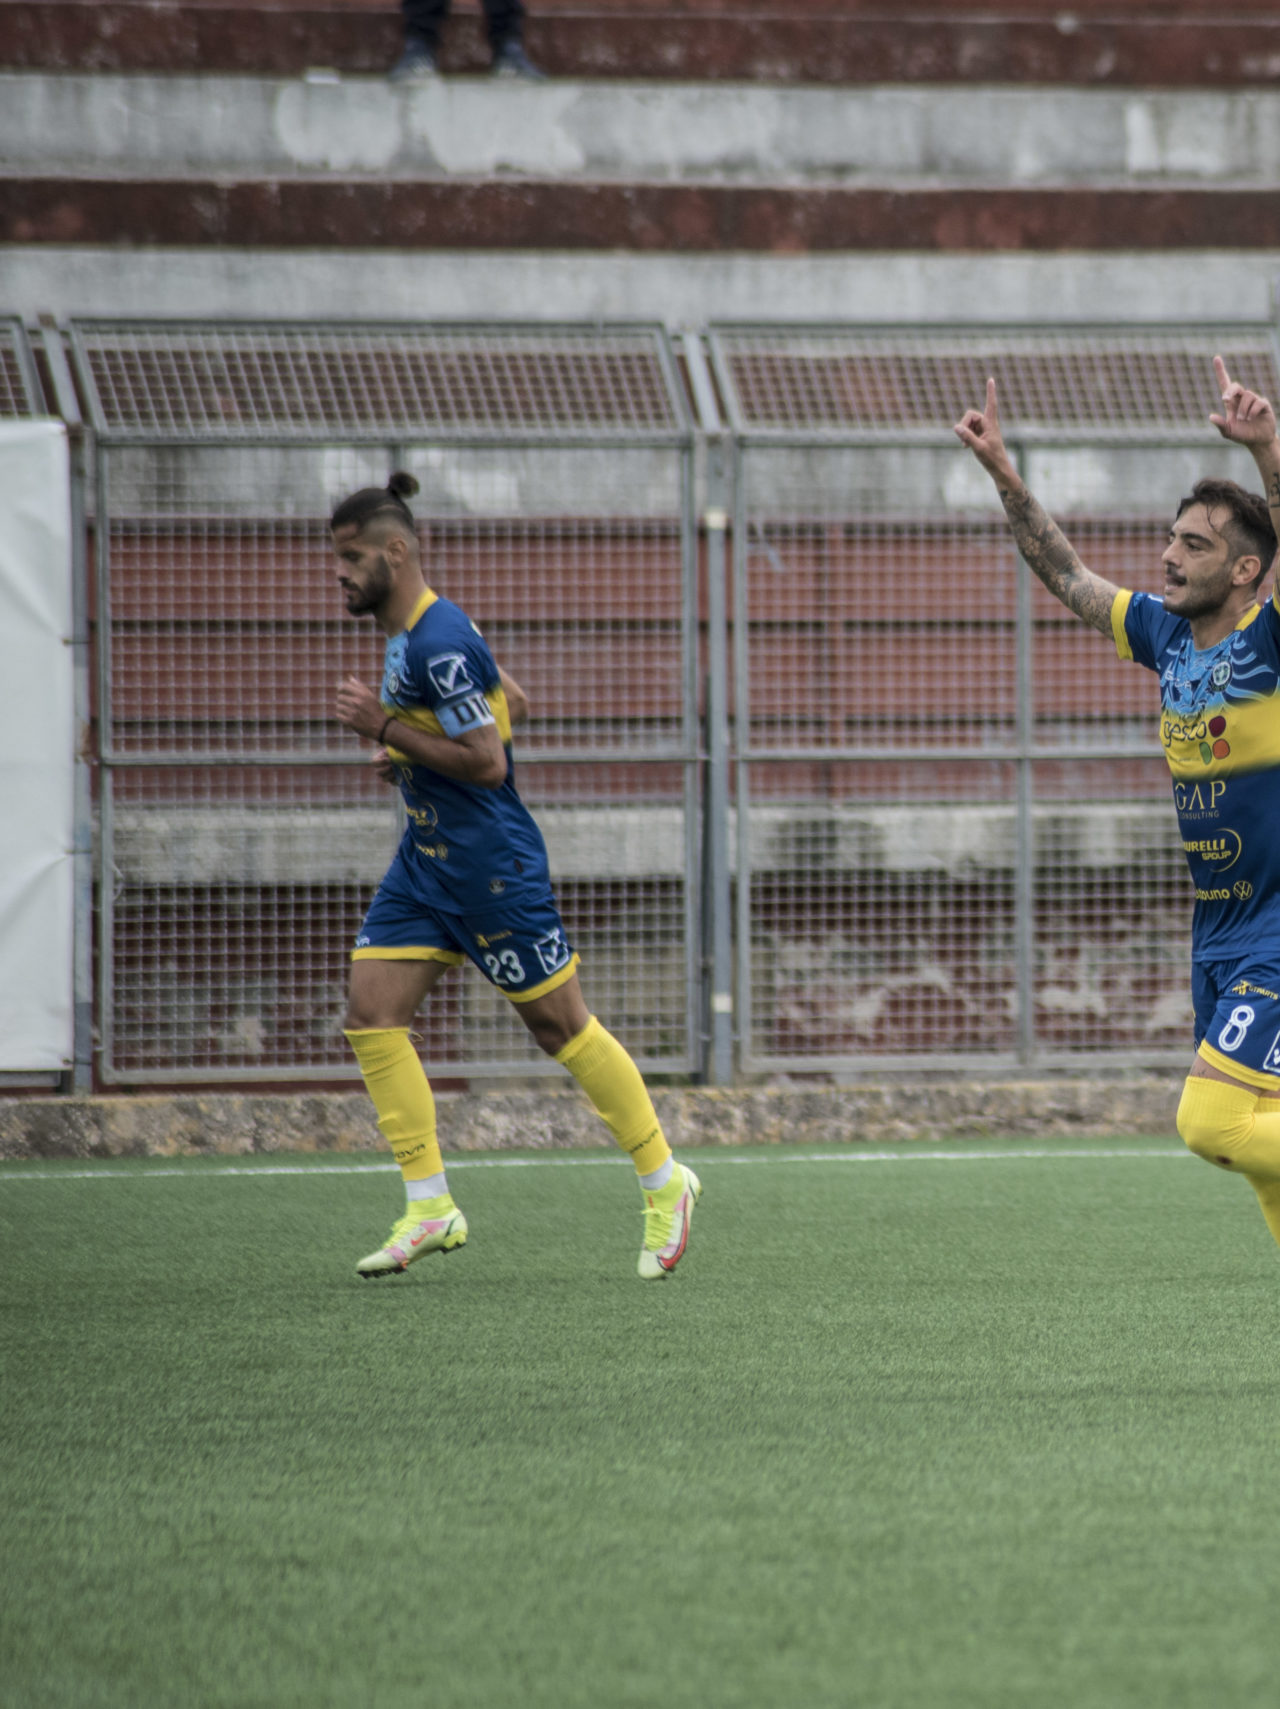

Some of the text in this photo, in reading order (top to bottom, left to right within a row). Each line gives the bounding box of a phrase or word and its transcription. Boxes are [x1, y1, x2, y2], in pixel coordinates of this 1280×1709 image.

[1175, 781, 1226, 810] GAP
[484, 950, 526, 985] 23
[1218, 1004, 1255, 1052] 8
